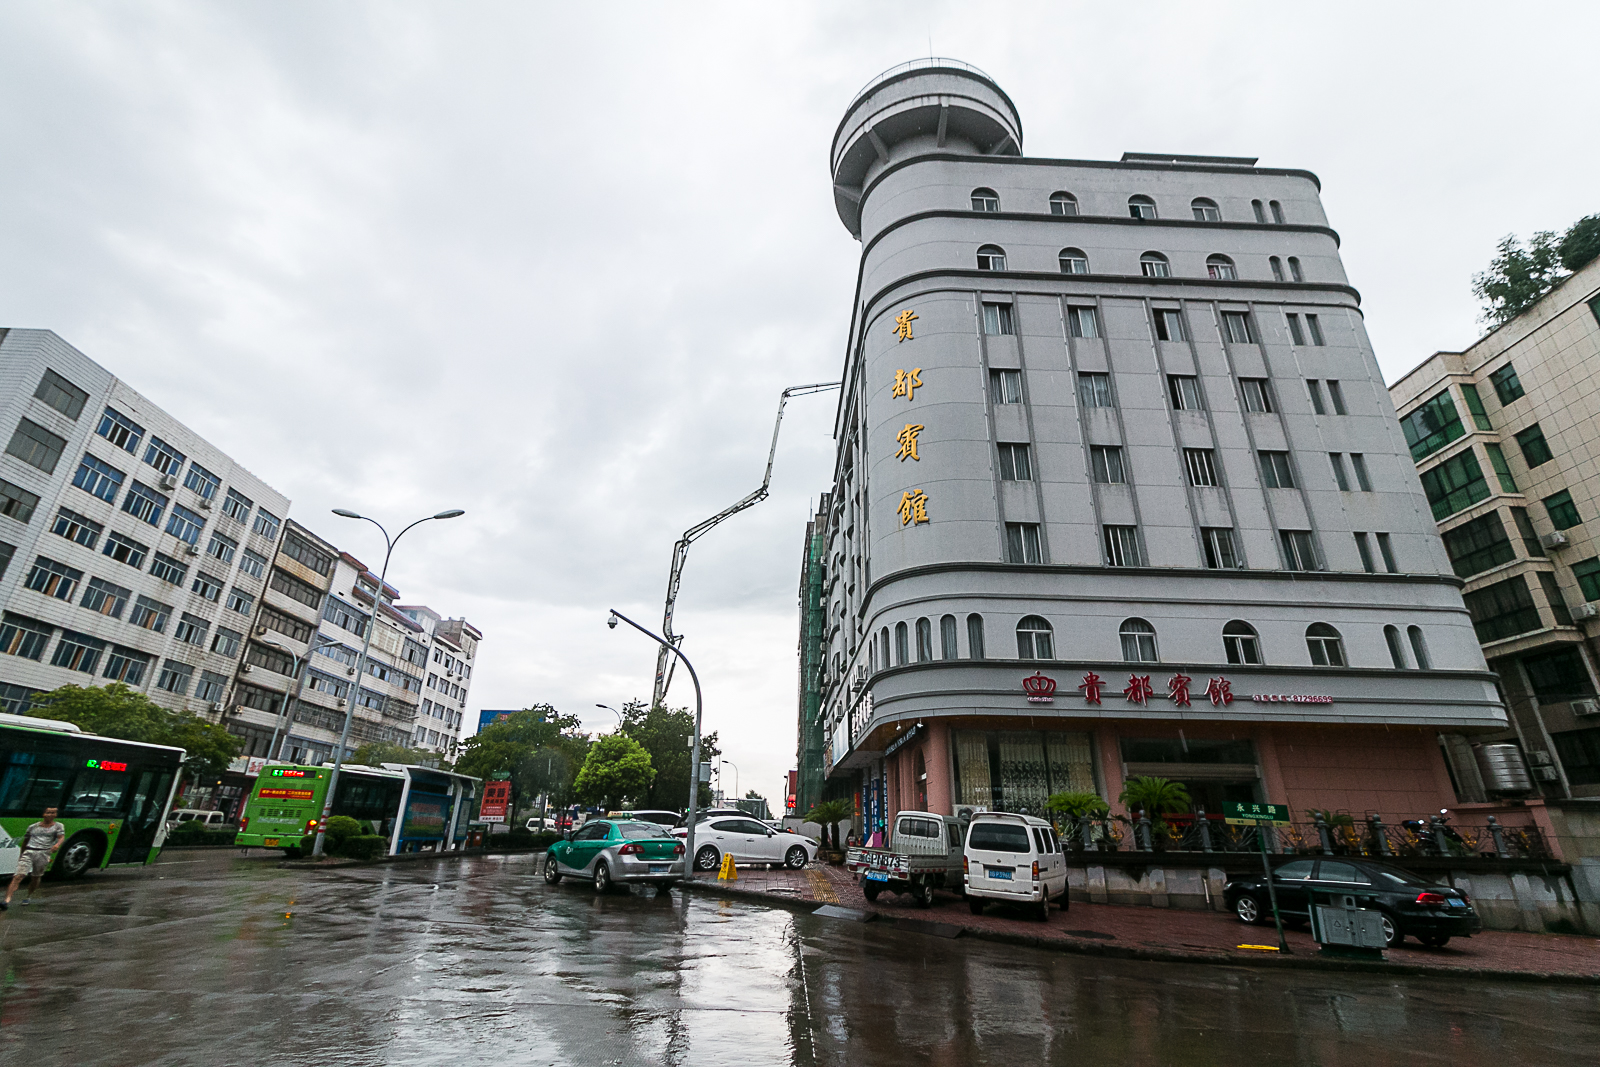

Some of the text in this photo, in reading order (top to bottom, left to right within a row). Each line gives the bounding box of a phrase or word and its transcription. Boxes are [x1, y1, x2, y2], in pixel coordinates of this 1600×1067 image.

[1078, 671, 1234, 707] 貴都賓館
[1236, 803, 1277, 815] 永兴路
